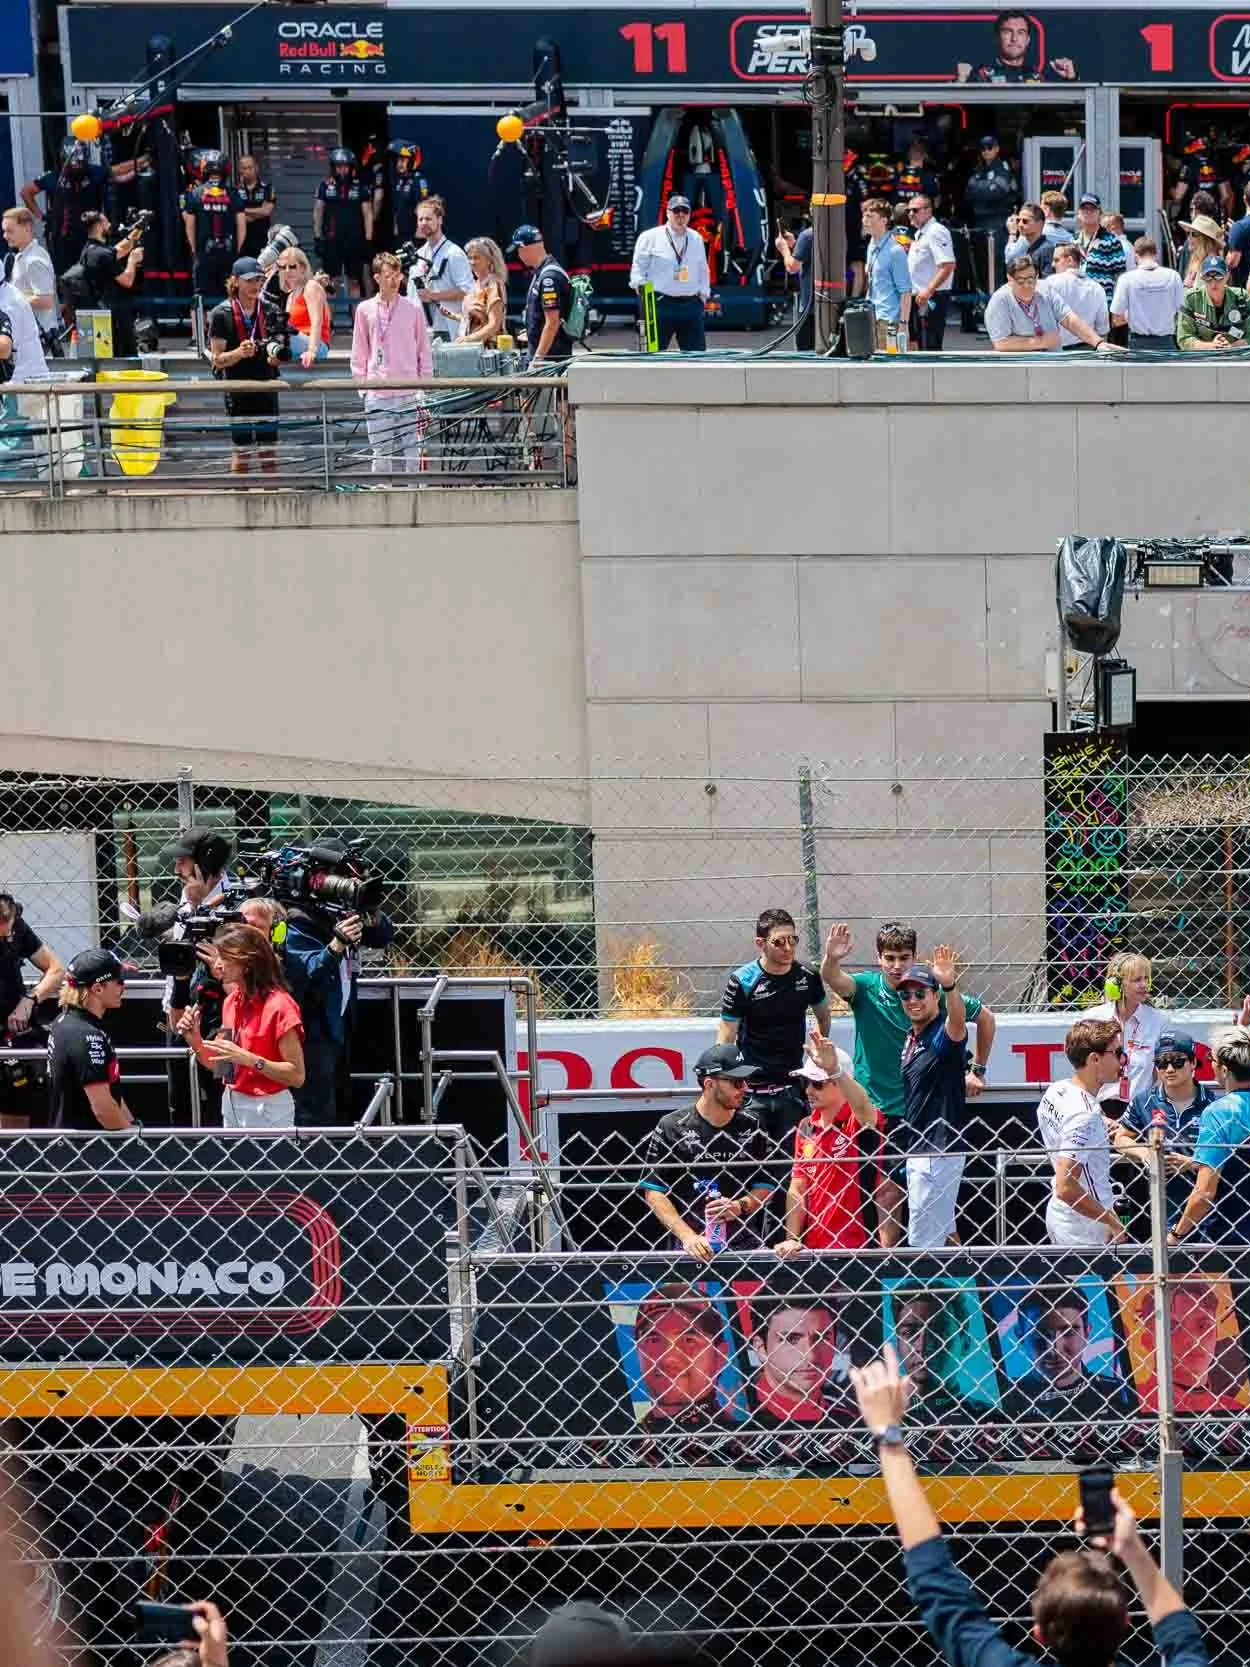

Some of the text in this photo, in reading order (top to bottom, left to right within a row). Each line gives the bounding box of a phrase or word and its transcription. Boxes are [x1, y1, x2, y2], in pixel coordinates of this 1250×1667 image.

[278, 22, 384, 38] ORACLE
[279, 41, 337, 57] Red Bull
[619, 23, 687, 72] 11
[1140, 24, 1173, 72] 1
[279, 64, 386, 74] RACING
[0, 1261, 286, 1297] E MONACO
